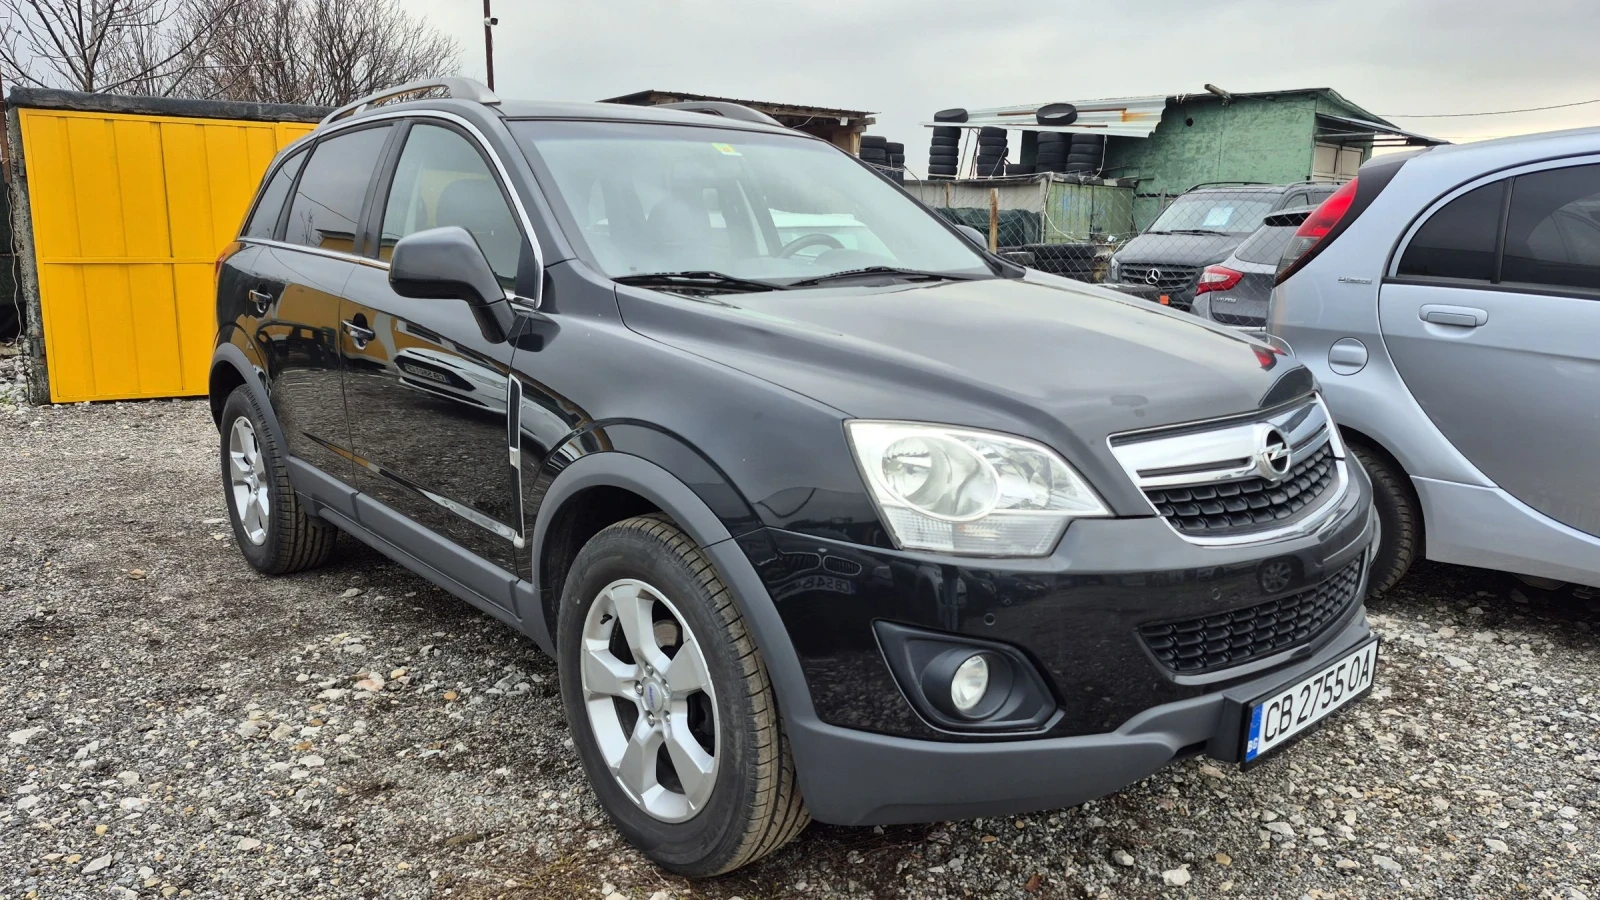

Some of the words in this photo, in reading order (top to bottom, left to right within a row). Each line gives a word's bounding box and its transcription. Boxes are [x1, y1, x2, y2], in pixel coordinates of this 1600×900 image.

[1264, 693, 1293, 743] CB
[1296, 663, 1346, 726] 2755
[1348, 649, 1371, 693] OA
[1247, 737, 1258, 753] BG
